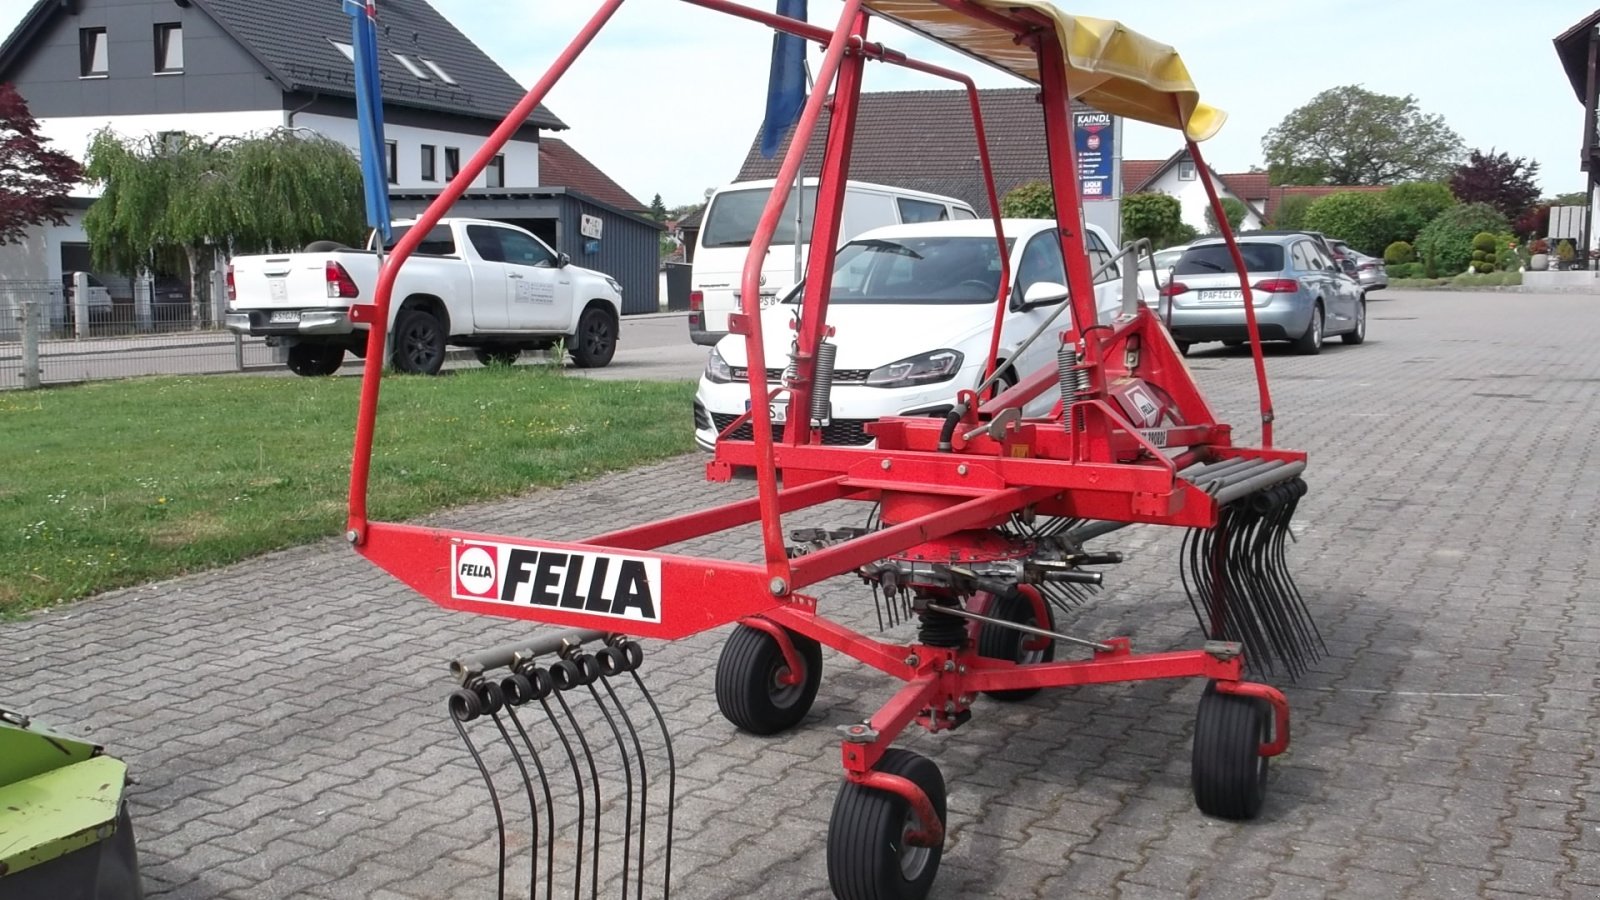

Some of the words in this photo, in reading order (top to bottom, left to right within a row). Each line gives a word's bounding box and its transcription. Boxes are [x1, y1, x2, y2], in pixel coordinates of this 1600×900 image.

[1078, 114, 1110, 123] KAINDL
[460, 563, 492, 579] FELLA
[501, 548, 657, 619] FELLA
